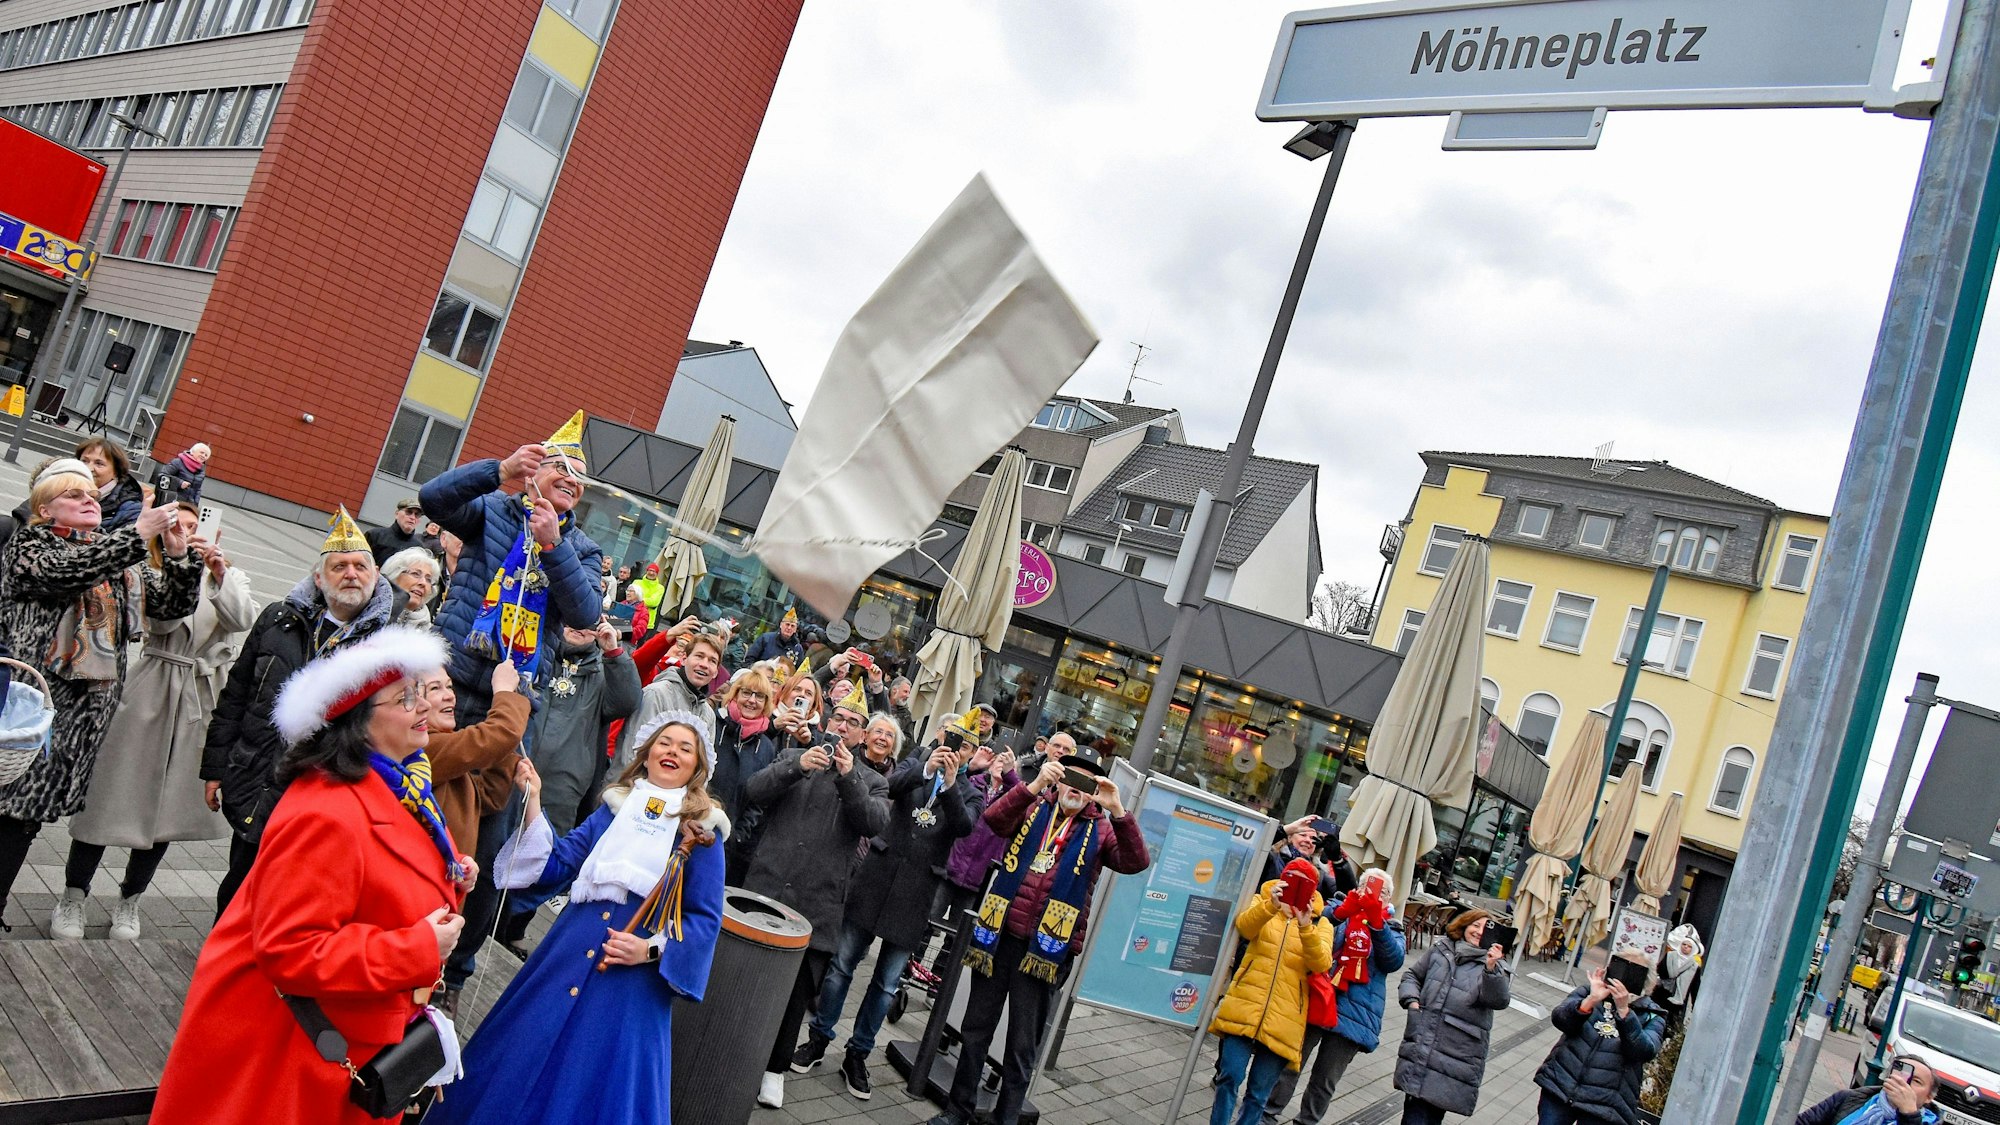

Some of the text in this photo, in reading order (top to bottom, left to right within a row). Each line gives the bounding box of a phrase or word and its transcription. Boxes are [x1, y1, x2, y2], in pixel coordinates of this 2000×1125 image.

[1410, 17, 1708, 80] Möhneplatz
[1020, 544, 1040, 561] TERIA
[1014, 596, 1026, 605] AFÉ
[1232, 824, 1255, 841] DU
[1151, 892, 1167, 900] CDU
[1174, 987, 1195, 996] CDU
